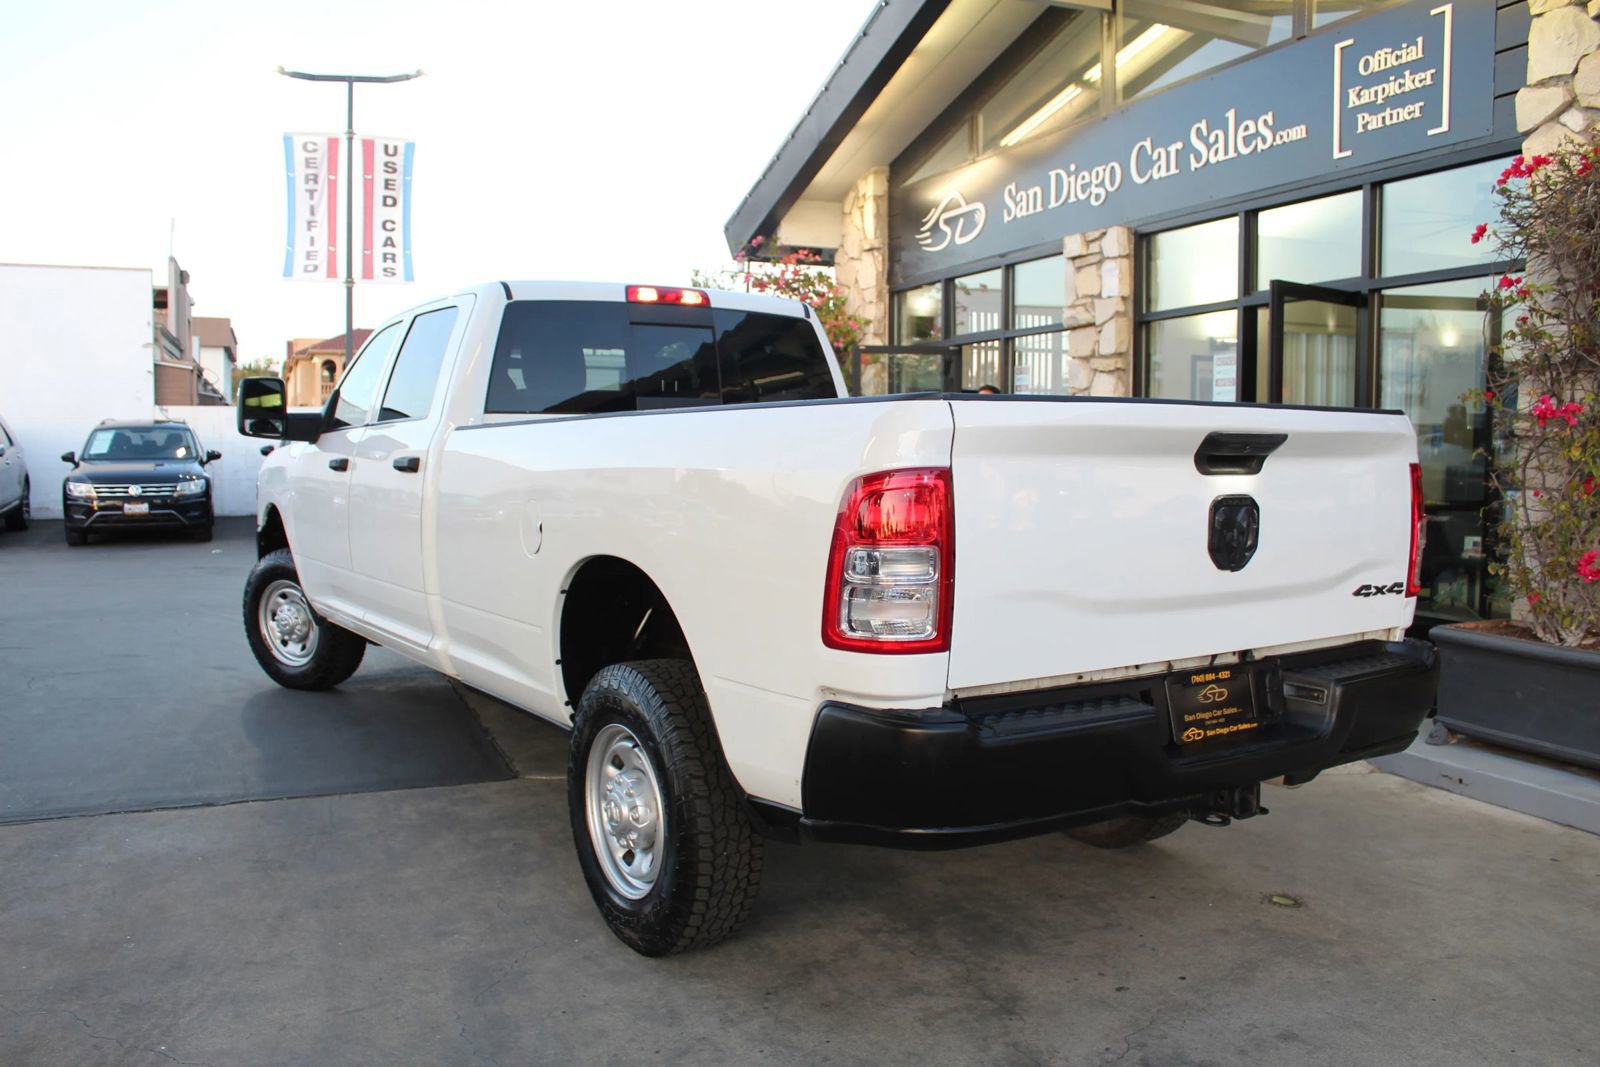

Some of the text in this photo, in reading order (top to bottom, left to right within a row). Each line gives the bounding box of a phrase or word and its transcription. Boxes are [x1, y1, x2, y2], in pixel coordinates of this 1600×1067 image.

[1358, 36, 1424, 76] Official
[1347, 69, 1436, 108] Karpicker
[1356, 102, 1424, 133] Partner
[1003, 108, 1307, 223] San Diego Car Sales.com
[302, 141, 318, 273] CERTIFIED
[381, 144, 398, 277] USED CARS
[1352, 581, 1404, 597] 4x4
[1196, 711, 1212, 719] Diego
[1213, 709, 1222, 717] Car
